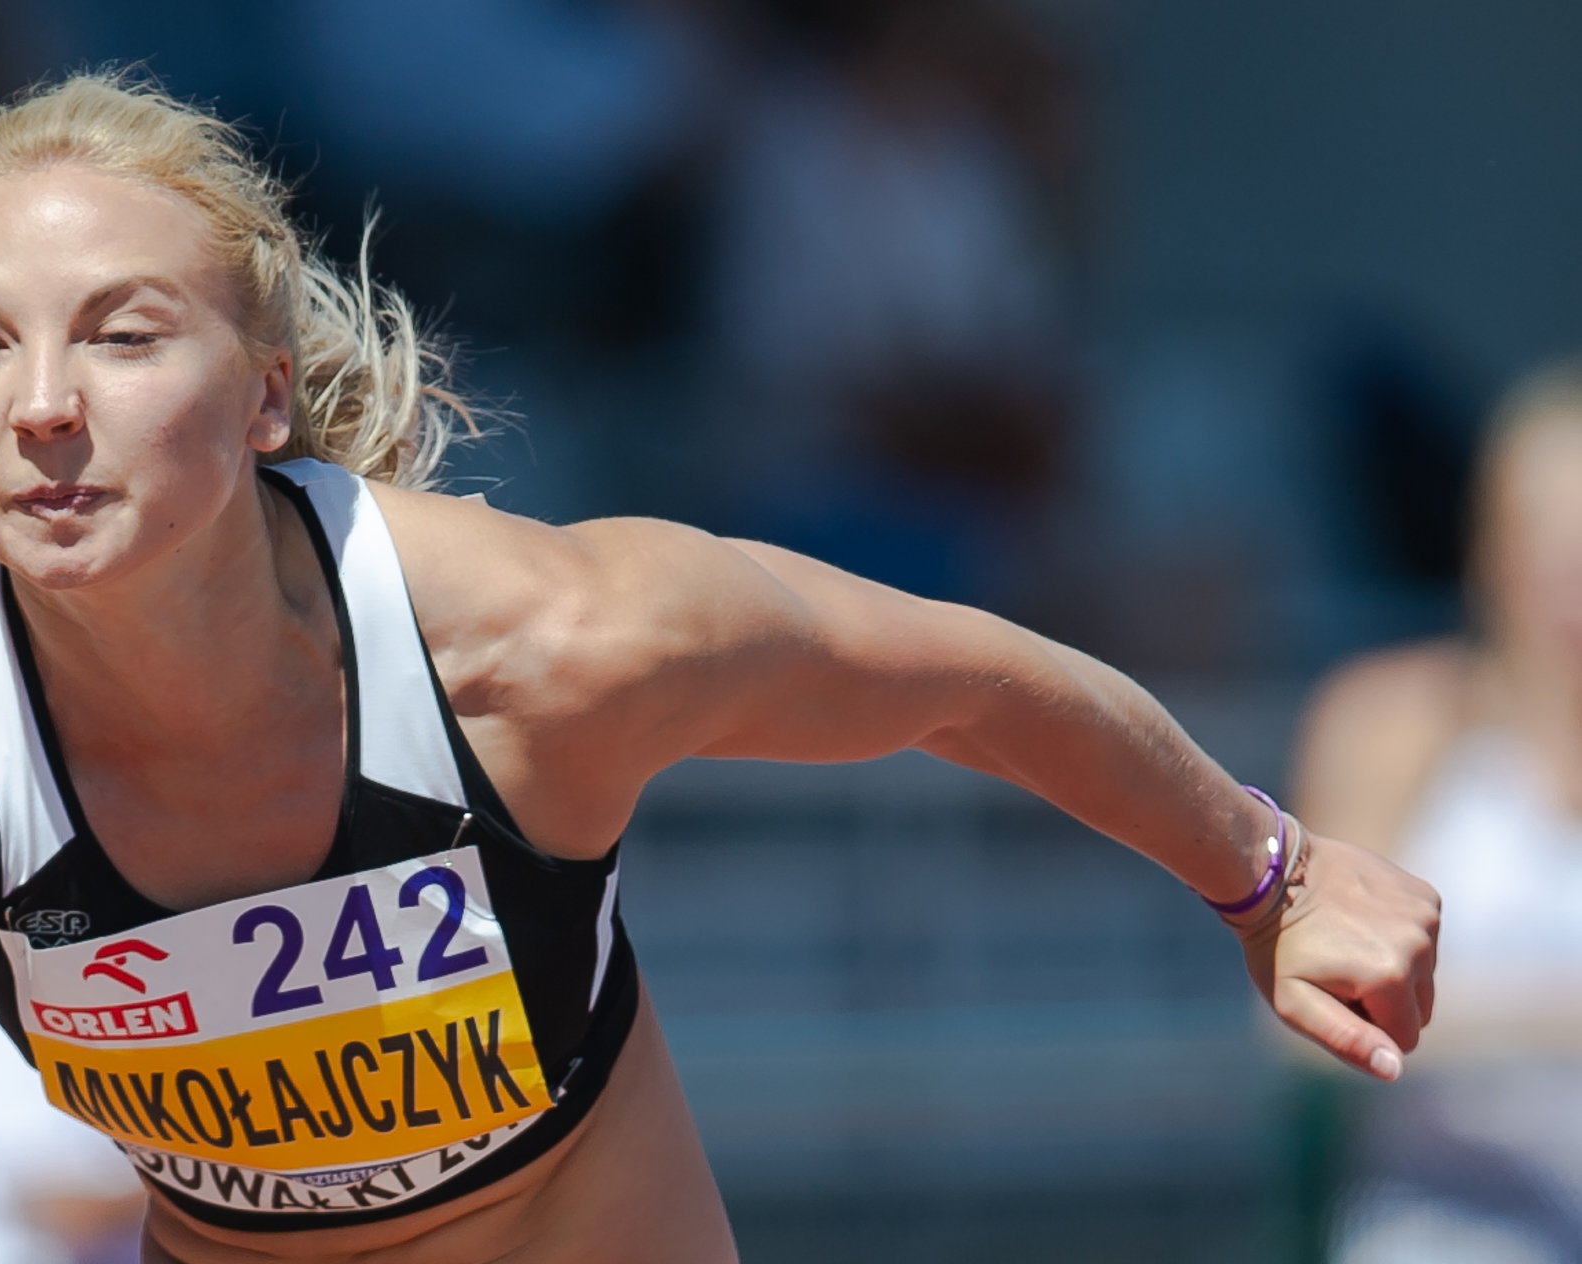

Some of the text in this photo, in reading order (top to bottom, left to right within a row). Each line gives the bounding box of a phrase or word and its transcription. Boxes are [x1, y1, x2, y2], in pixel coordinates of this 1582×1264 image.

[232, 865, 489, 1018] 242
[40, 1006, 188, 1038] ORLEN
[53, 1008, 531, 1150] MIKOŁAJCZYK
